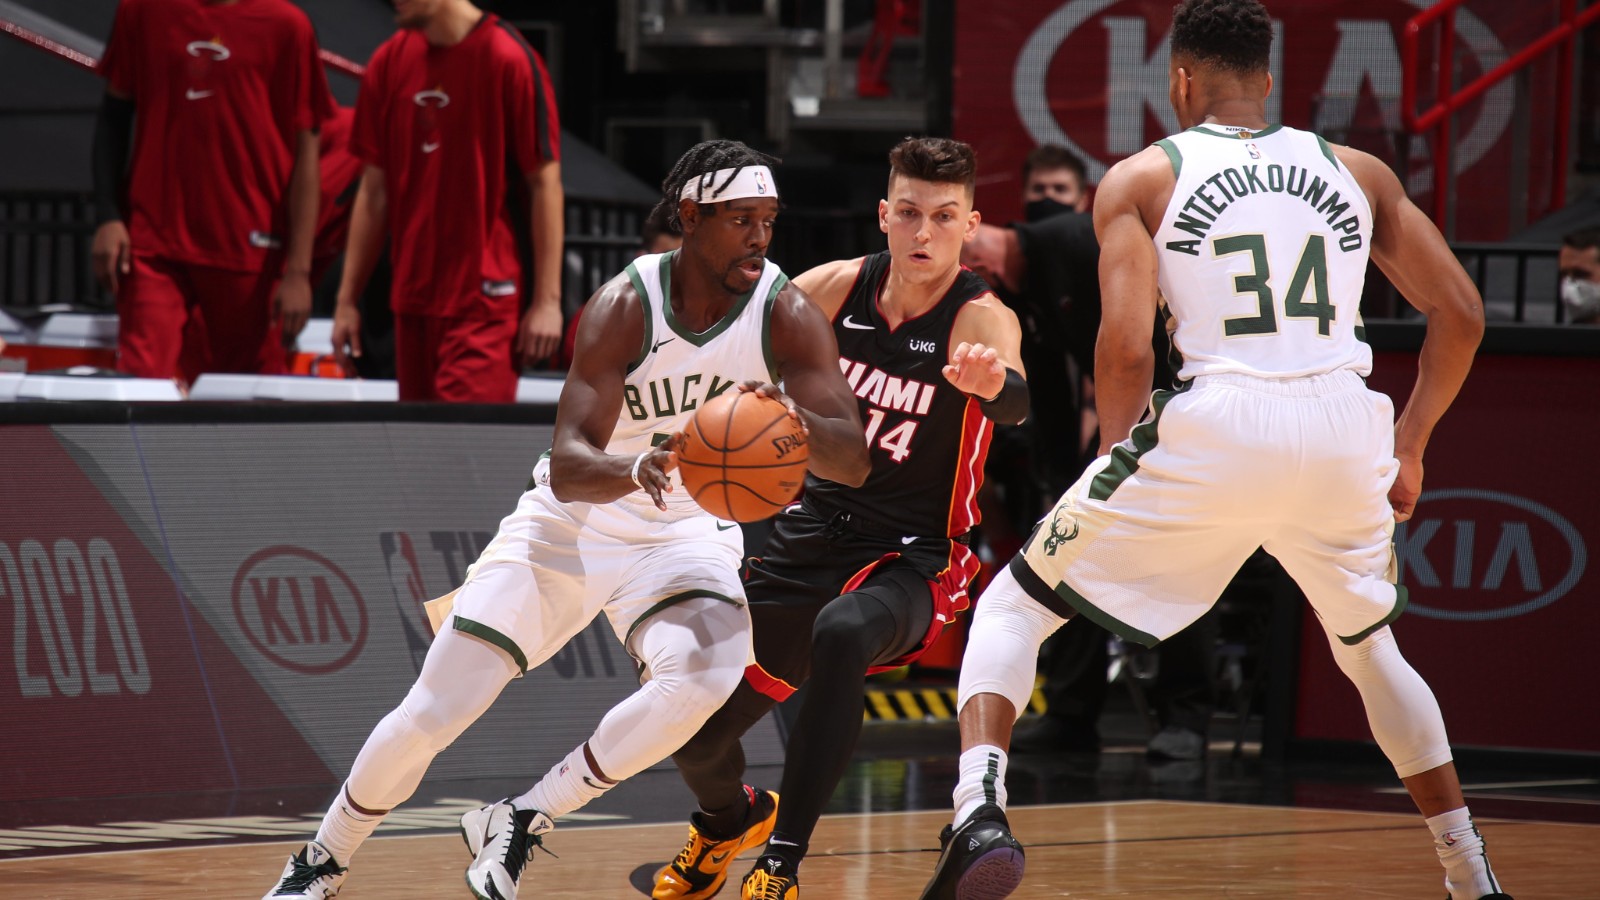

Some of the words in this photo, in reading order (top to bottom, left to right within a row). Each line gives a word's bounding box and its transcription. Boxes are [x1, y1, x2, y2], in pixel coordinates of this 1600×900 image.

[1166, 164, 1362, 256] ANTETOKOUNMPO
[1210, 232, 1337, 338] 34
[909, 339, 936, 353] UKG
[624, 373, 735, 421] BUCK
[838, 356, 936, 416] IAMI
[772, 430, 807, 460] SPAL
[864, 408, 920, 463] 14
[1394, 518, 1544, 593] KIA
[0, 537, 153, 698] 2020
[248, 575, 354, 645] KIA
